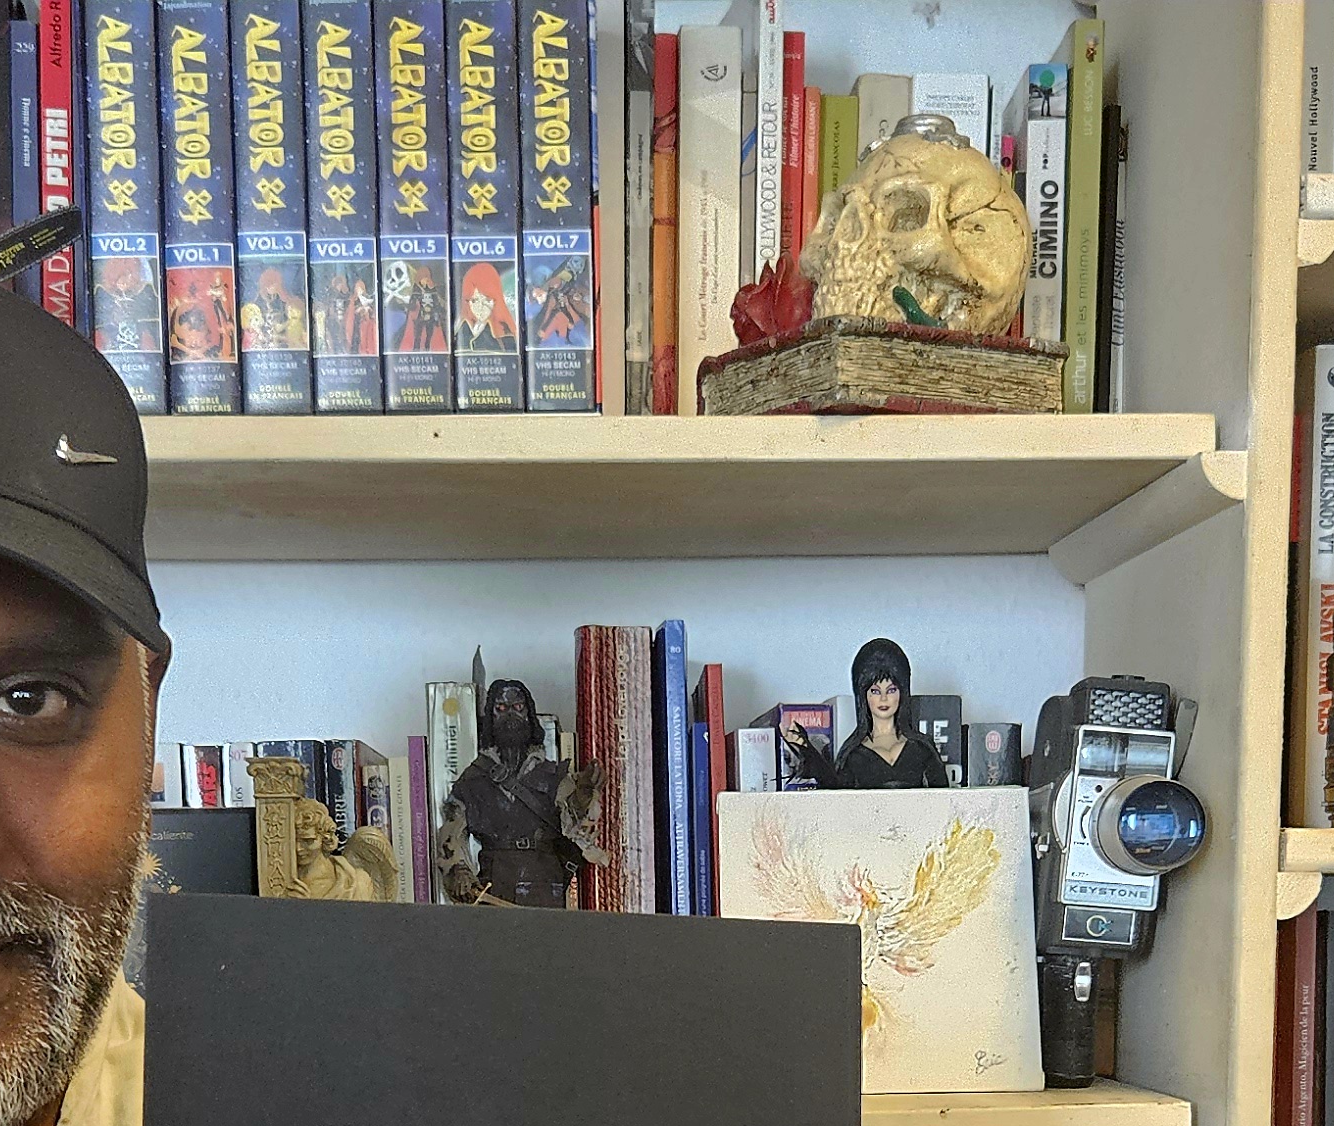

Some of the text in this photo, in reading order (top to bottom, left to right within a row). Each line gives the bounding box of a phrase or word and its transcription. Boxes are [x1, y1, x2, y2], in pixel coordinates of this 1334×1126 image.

[49, 21, 61, 67] Alfredo
[96, 14, 138, 215] ALBATOR 84
[171, 24, 214, 225] ALBATOR 84
[245, 12, 287, 213] ALBATOR 84
[318, 20, 357, 219] ALBATOR 84
[390, 17, 429, 217] ALBATOR 84
[459, 17, 498, 219] ALBATOR 84
[532, 12, 571, 213] ALBATOR 84
[761, 103, 777, 158] RETOUR
[45, 108, 70, 188] PETRI
[98, 235, 147, 253] VOL.2
[173, 246, 220, 264] VOL.1
[246, 234, 294, 251] VOL.3
[316, 241, 364, 258] VOL.4
[388, 239, 437, 255] VOL.5
[458, 240, 505, 256] VOL.6
[532, 235, 580, 249] VOL.7
[1039, 180, 1058, 279] CIMINO
[1073, 306, 1086, 404] arthur et les
[674, 781, 683, 809] TONA
[1069, 886, 1147, 898] KEYSTONE
